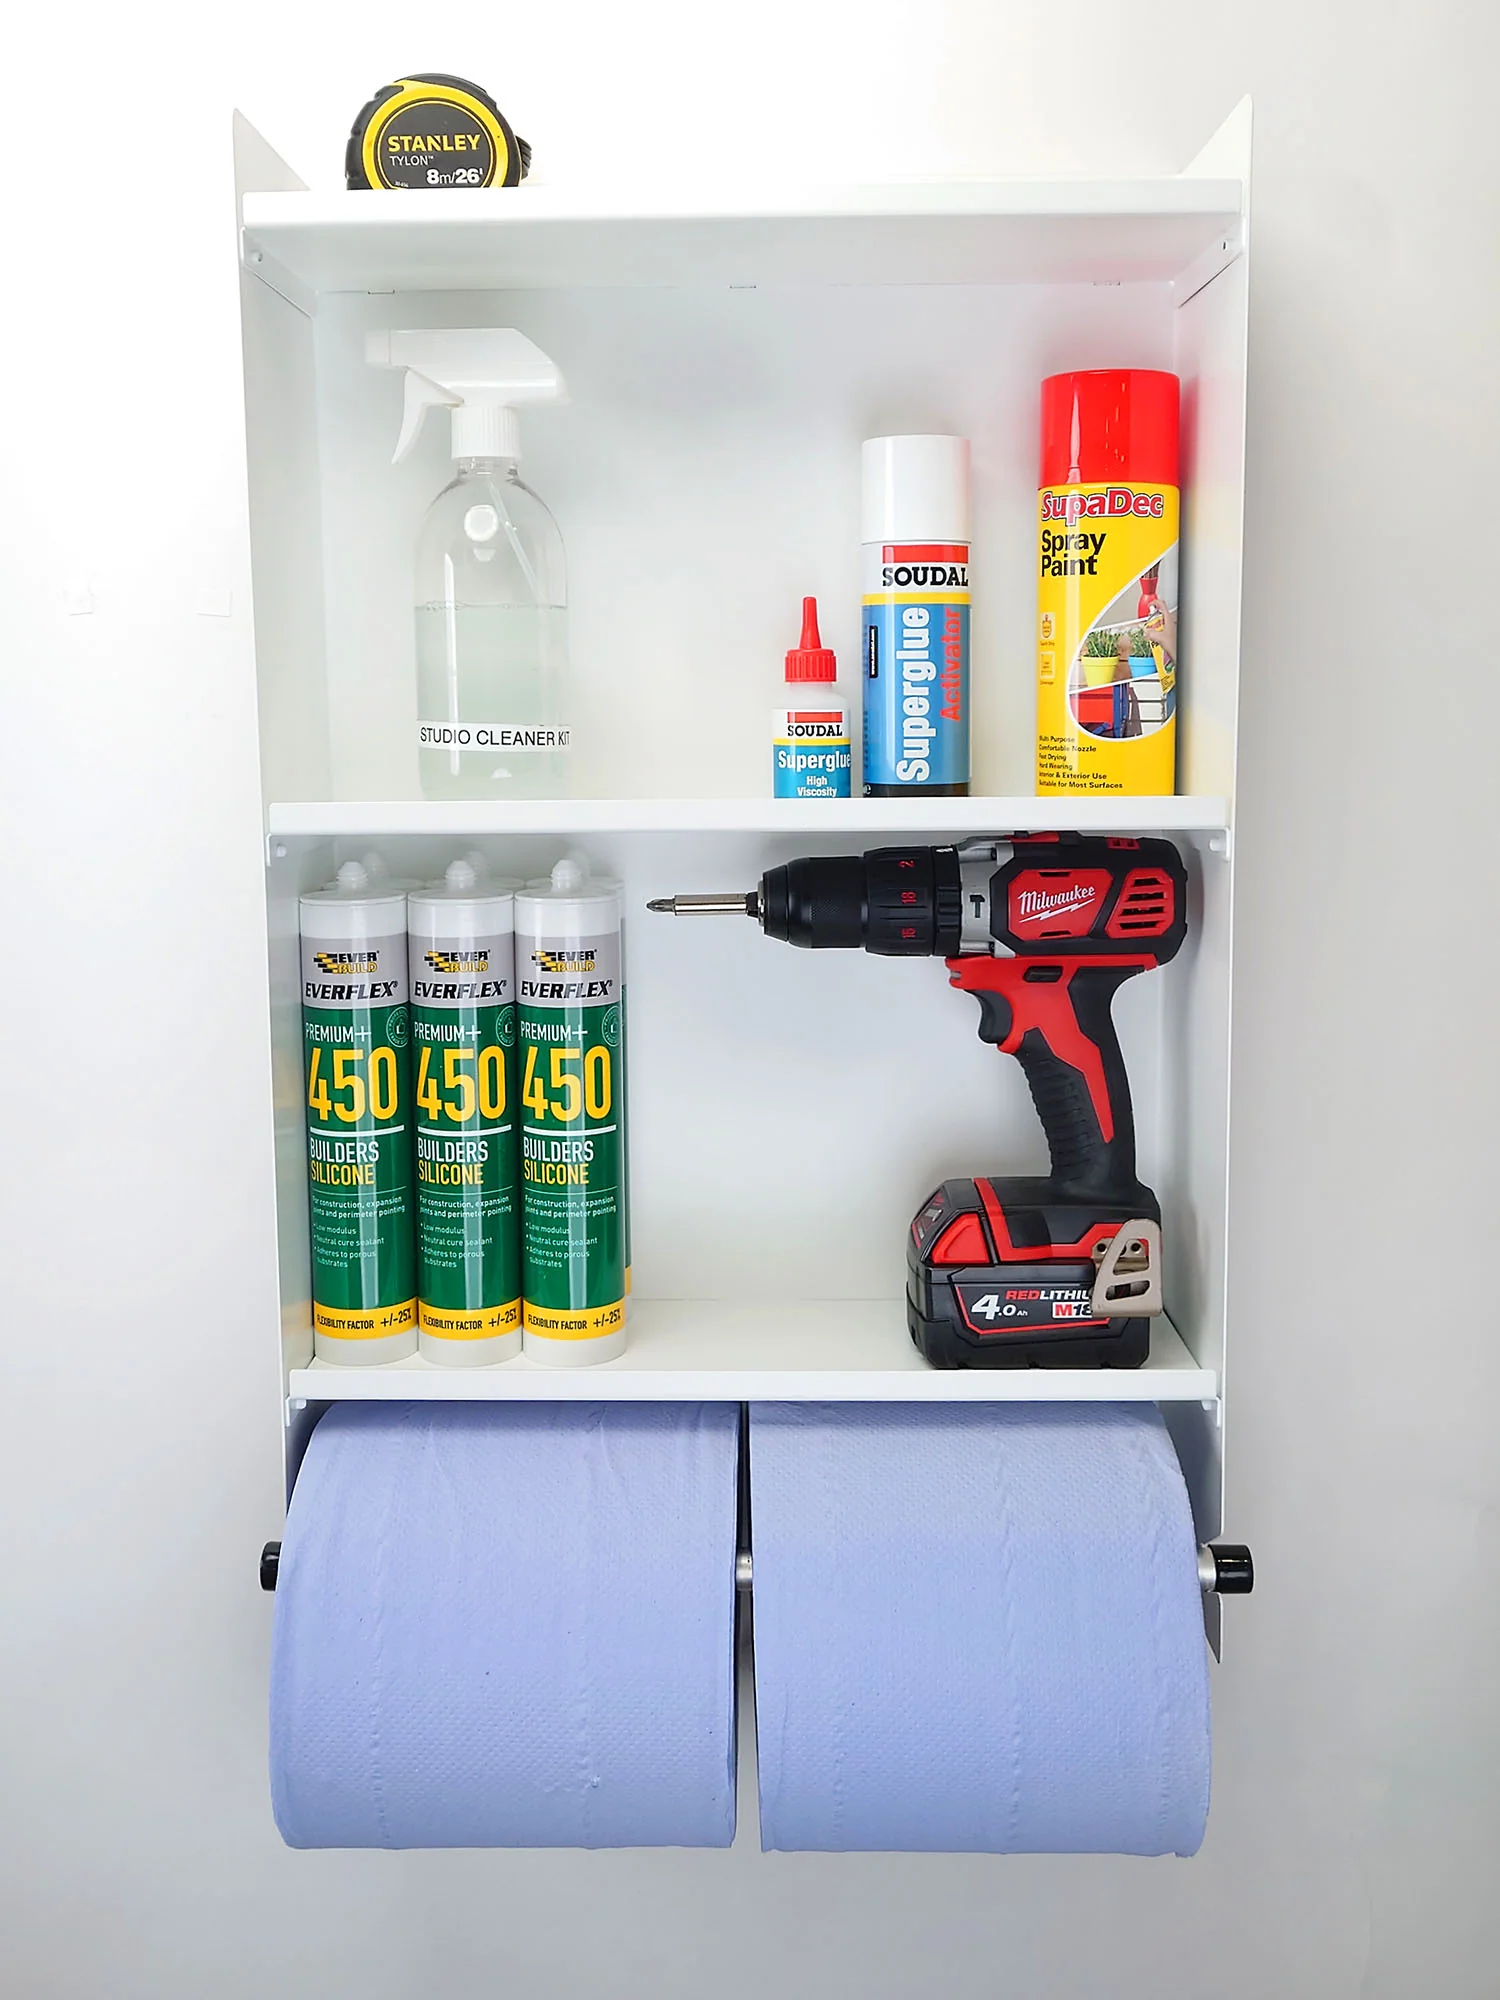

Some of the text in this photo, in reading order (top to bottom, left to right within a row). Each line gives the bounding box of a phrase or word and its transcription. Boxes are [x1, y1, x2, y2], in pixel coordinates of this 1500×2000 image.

[386, 134, 481, 152] STANLEY
[1042, 487, 1163, 526] SupaDec
[1042, 529, 1106, 556] Spray
[1042, 554, 1098, 577] Paint
[882, 566, 969, 588] SOUDAL
[940, 608, 961, 722] Activator
[896, 607, 936, 782] Superglue
[420, 727, 570, 746] STUDIO CLEANER KIT
[787, 724, 843, 737] SOUDAL
[778, 750, 851, 773] Superglue
[806, 775, 828, 787] High
[1089, 781, 1123, 789] Surfaces
[797, 786, 837, 798] Viscosity
[1017, 884, 1096, 915] Milwaukee
[339, 962, 378, 974] BUILD
[450, 961, 489, 973] BUILD
[557, 960, 595, 972] BUILD
[309, 1046, 398, 1122] 450
[417, 1045, 506, 1122] 450
[523, 1045, 611, 1122] 450
[310, 1137, 380, 1163] BUILDERS
[418, 1137, 489, 1163] BUILDERS
[523, 1137, 594, 1163] BUILDERS
[311, 1162, 375, 1186] SILICONE
[418, 1161, 484, 1186] SILICONE
[524, 1161, 589, 1186] SILICONE
[319, 1199, 365, 1209] construction,
[366, 1196, 402, 1208] expansion
[427, 1199, 474, 1209] construction,
[475, 1195, 509, 1207] expansion
[533, 1199, 580, 1208] construction,
[580, 1195, 614, 1207] expansion
[338, 1210, 377, 1219] perimeter
[378, 1205, 405, 1217] pointing
[447, 1210, 486, 1219] perimeter
[487, 1205, 512, 1217] pointing
[553, 1210, 591, 1218] perimeter
[592, 1205, 617, 1217] pointing
[326, 1226, 357, 1235] modulus
[434, 1226, 465, 1234] modulus
[540, 1226, 570, 1234] modulus
[347, 1319, 375, 1330] FACTOR
[423, 1314, 454, 1330] FLEXIBILITY
[455, 1320, 482, 1330] FACTOR
[528, 1314, 559, 1329] FLEXIBILITY
[560, 1320, 587, 1330] FACTOR
